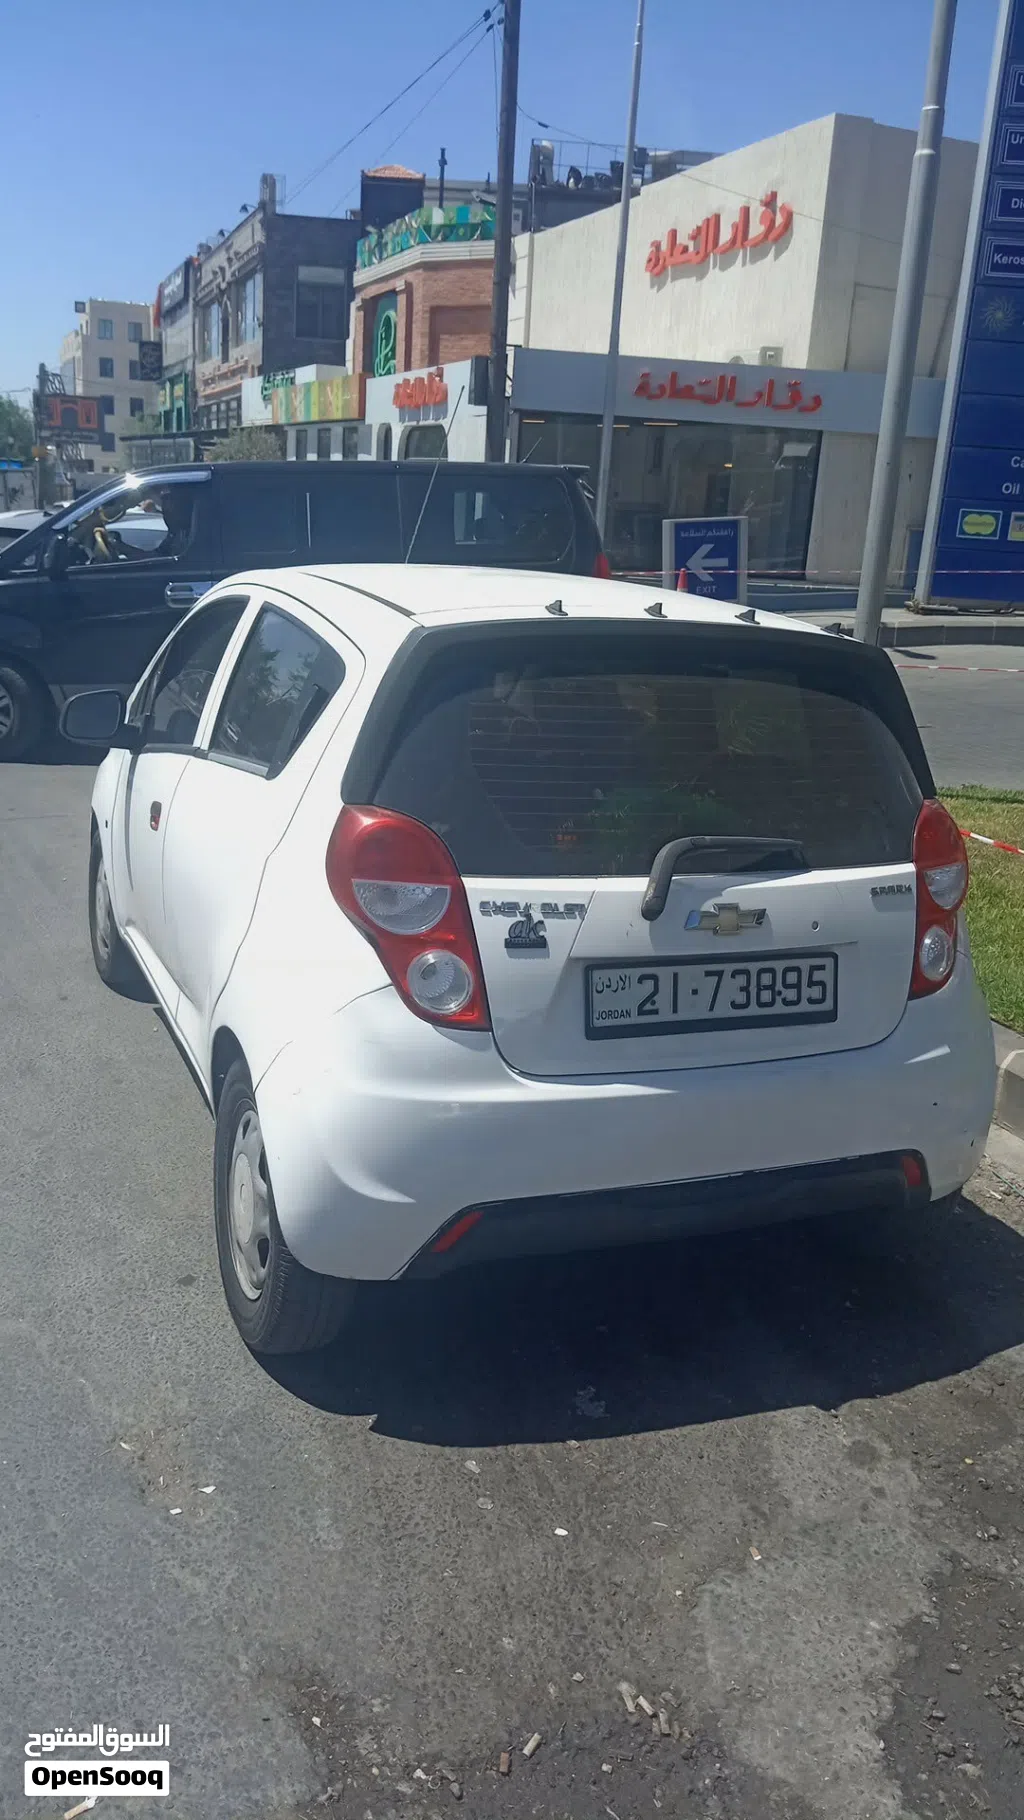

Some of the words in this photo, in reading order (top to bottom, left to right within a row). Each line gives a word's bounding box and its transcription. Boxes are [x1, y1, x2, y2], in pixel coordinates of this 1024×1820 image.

[1001, 482, 1021, 495] Oil
[696, 585, 717, 594] EXIT
[870, 884, 912, 897] SPARK
[479, 900, 587, 915] CHEVOLET
[595, 1008, 632, 1021] JORDAN
